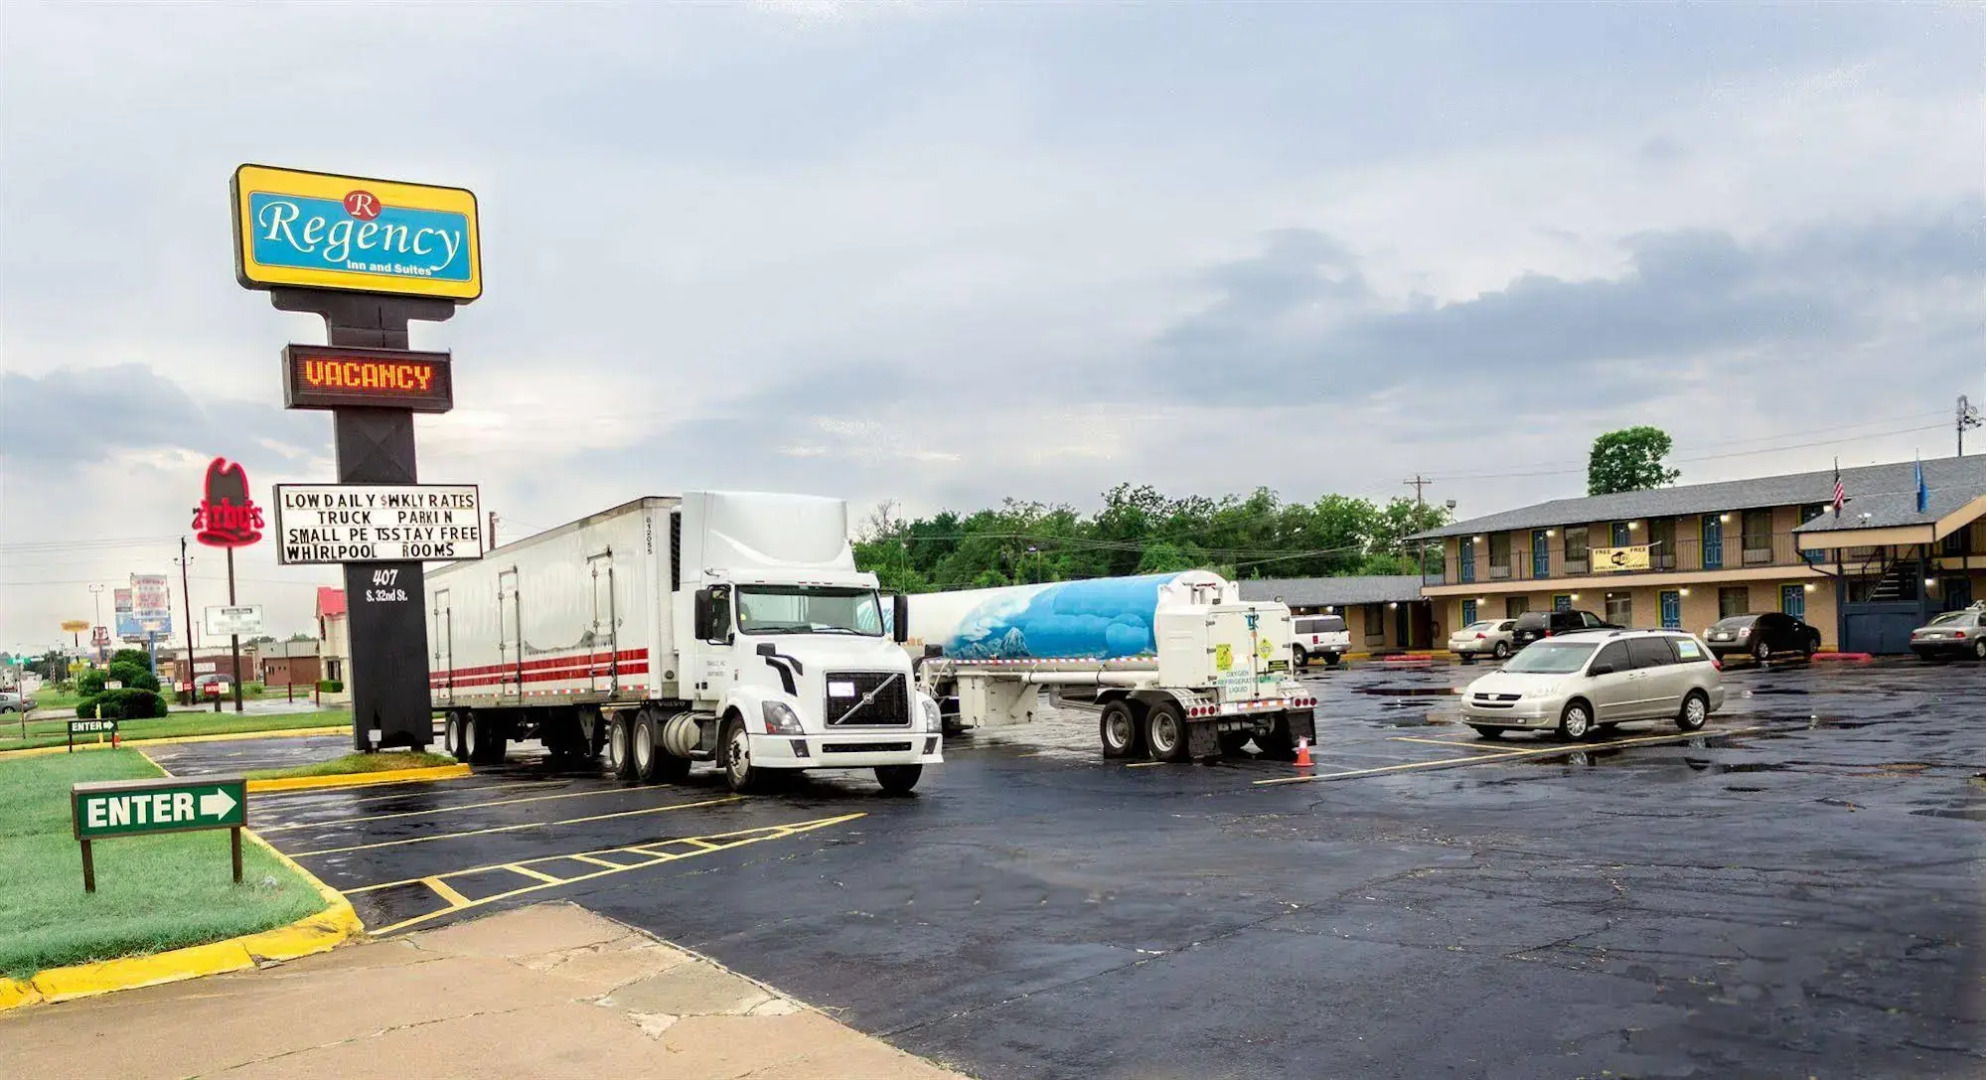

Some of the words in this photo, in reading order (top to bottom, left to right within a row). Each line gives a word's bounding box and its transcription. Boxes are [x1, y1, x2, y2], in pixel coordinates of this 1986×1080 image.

[348, 194, 377, 217] R
[259, 201, 460, 272] Regency
[347, 259, 366, 271] Inn
[369, 262, 392, 273] and
[394, 264, 432, 276] Suites
[306, 360, 431, 389] VACANCY
[286, 494, 319, 508] LOW
[324, 494, 375, 507] DAILY
[429, 494, 474, 508] RATES
[192, 497, 266, 536] Arby's
[317, 511, 371, 524] TRUCK
[289, 528, 340, 543] SMALL
[441, 527, 478, 540] FREE
[287, 544, 377, 560] WHIRLPOOL
[402, 543, 454, 557] ROOMS
[372, 569, 399, 586] 407
[366, 589, 375, 602] S.
[375, 589, 396, 602] 32nd
[397, 589, 408, 602] St.
[72, 721, 103, 731] ENTER
[88, 792, 195, 828] ENTER
